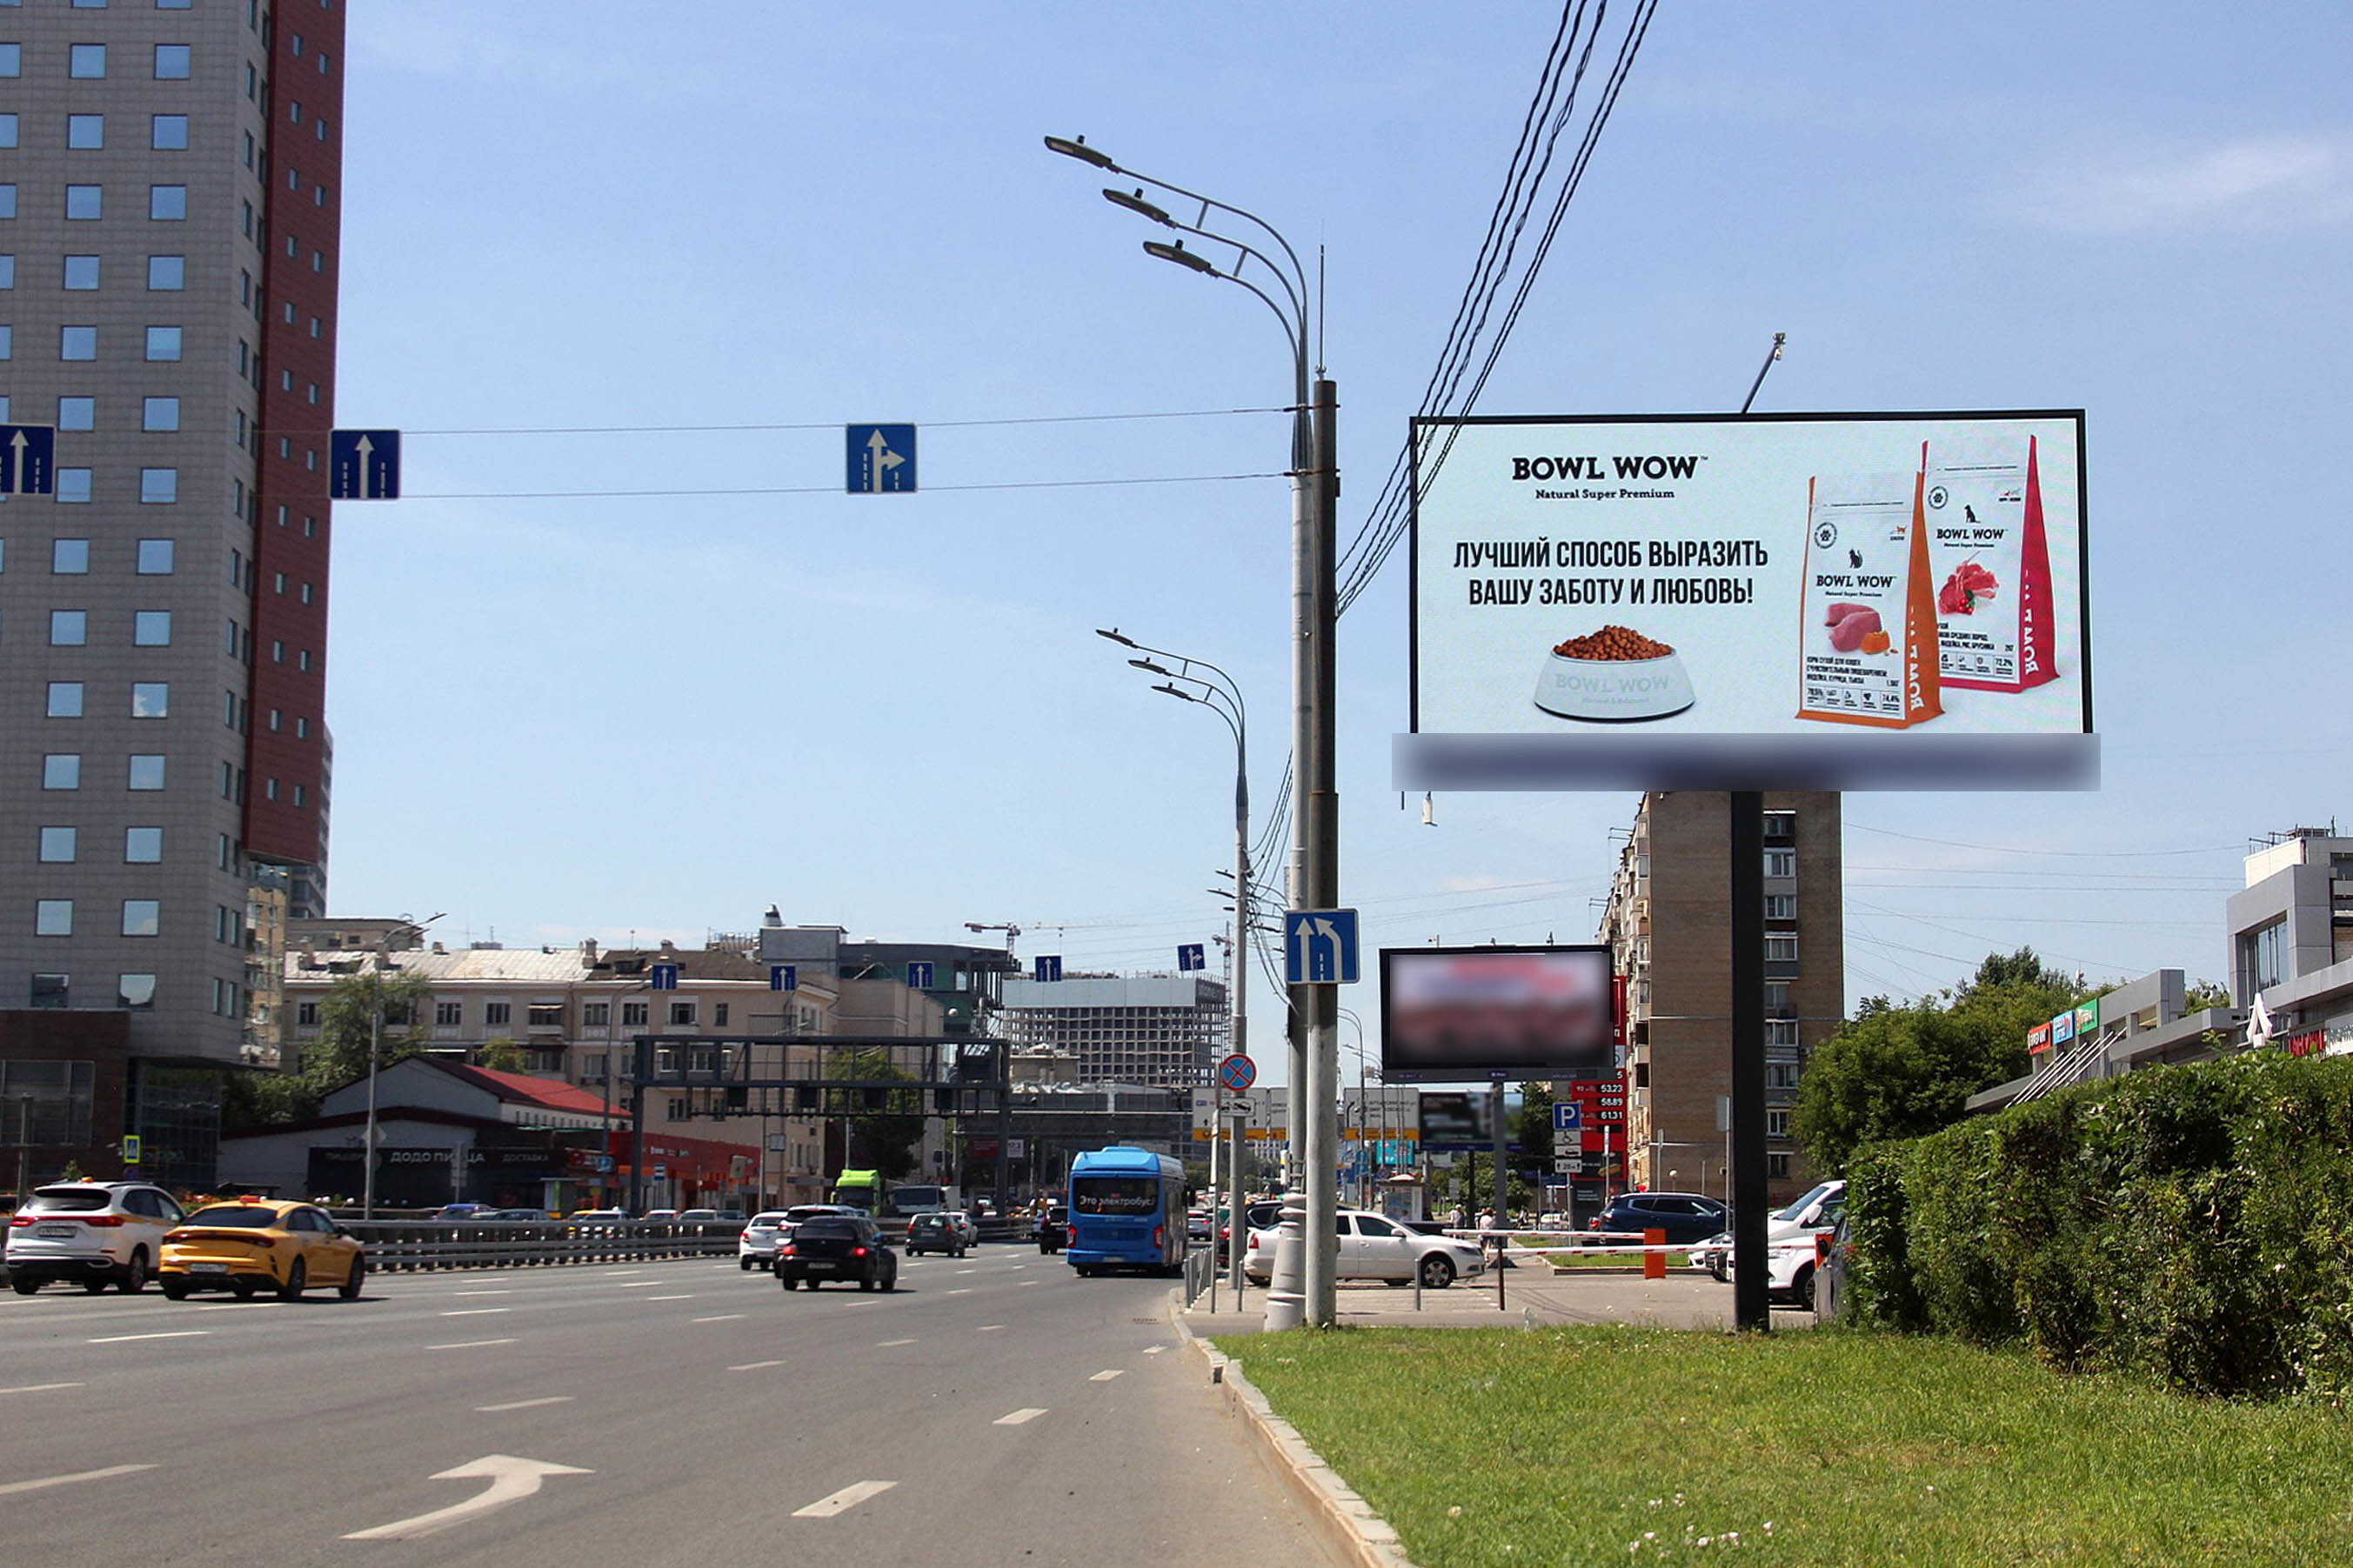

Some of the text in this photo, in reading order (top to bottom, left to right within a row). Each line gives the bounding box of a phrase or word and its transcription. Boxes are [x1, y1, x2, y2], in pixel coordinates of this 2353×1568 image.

[1512, 457, 1605, 480] BOWL
[1535, 488, 1675, 501] Natural Super Premium
[1936, 528, 1969, 539] BOWL
[1454, 537, 1768, 567] ЛУЧШИЙ СПОСОБ ВЫРАЗИТЬ
[1816, 575, 1854, 587] BOWL
[1469, 577, 1753, 604] ВАШУ ЗАБОТУ И ЛЮБОВЬ!
[1555, 674, 1670, 693] BOWL WOW
[390, 1151, 431, 1163] ДОДО
[1080, 1195, 1097, 1205] Это
